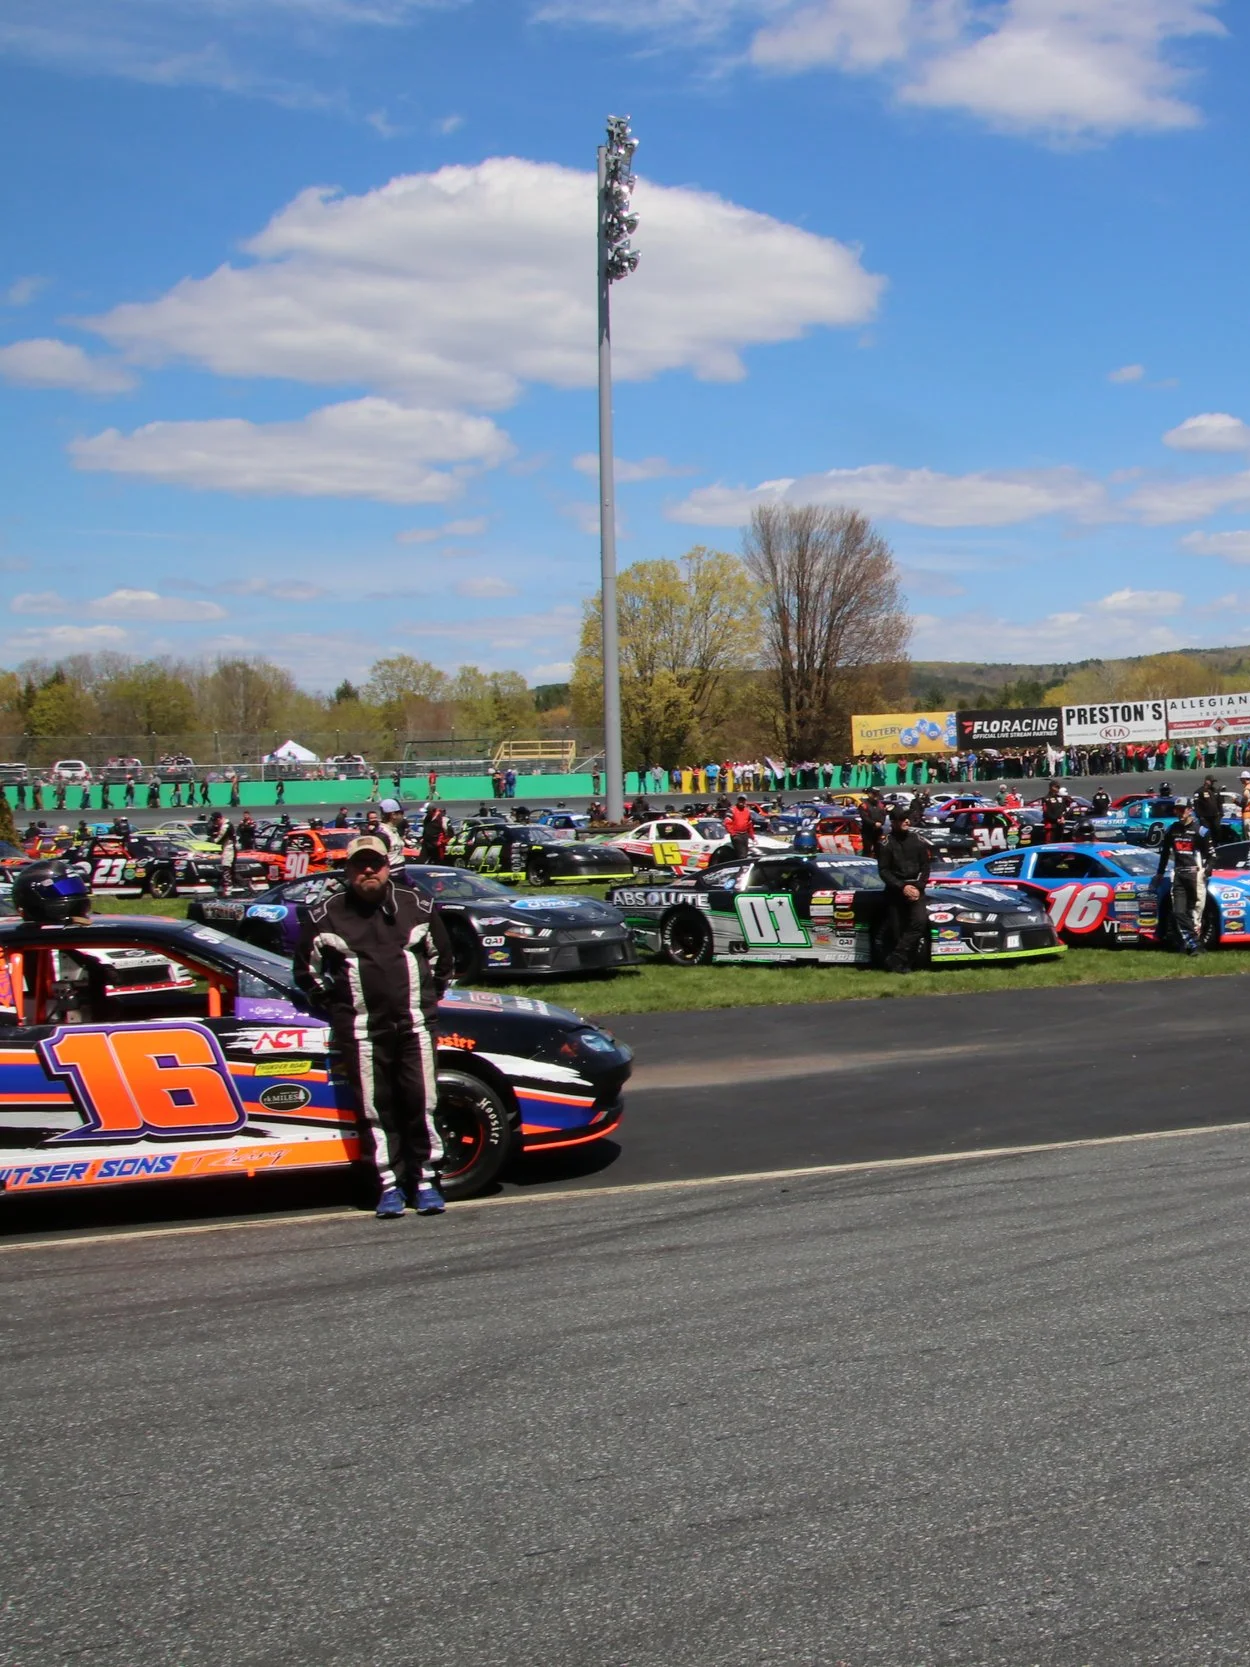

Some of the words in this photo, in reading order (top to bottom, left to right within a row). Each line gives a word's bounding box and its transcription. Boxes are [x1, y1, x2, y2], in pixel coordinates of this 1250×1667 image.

[1066, 703, 1163, 726] PRESTON'S
[1200, 709, 1238, 717] TRUCKS
[860, 727, 903, 738] LOTTERY
[973, 718, 1058, 734] FLORACING
[1105, 729, 1125, 737] KIA
[973, 827, 1008, 851] 34
[652, 842, 682, 866] 15
[93, 859, 127, 885] 23
[285, 852, 309, 879] 90
[613, 891, 709, 907] ABSOLUTE
[1048, 882, 1114, 933] 16
[252, 906, 280, 919] Ford
[735, 894, 812, 948] 01
[1103, 921, 1120, 933] VT
[255, 1029, 308, 1050] ACT
[437, 1032, 476, 1050] sier
[36, 1022, 248, 1143] 16
[273, 1093, 299, 1101] MILES
[476, 1097, 503, 1145] Hoosier
[96, 1154, 180, 1178] SONS
